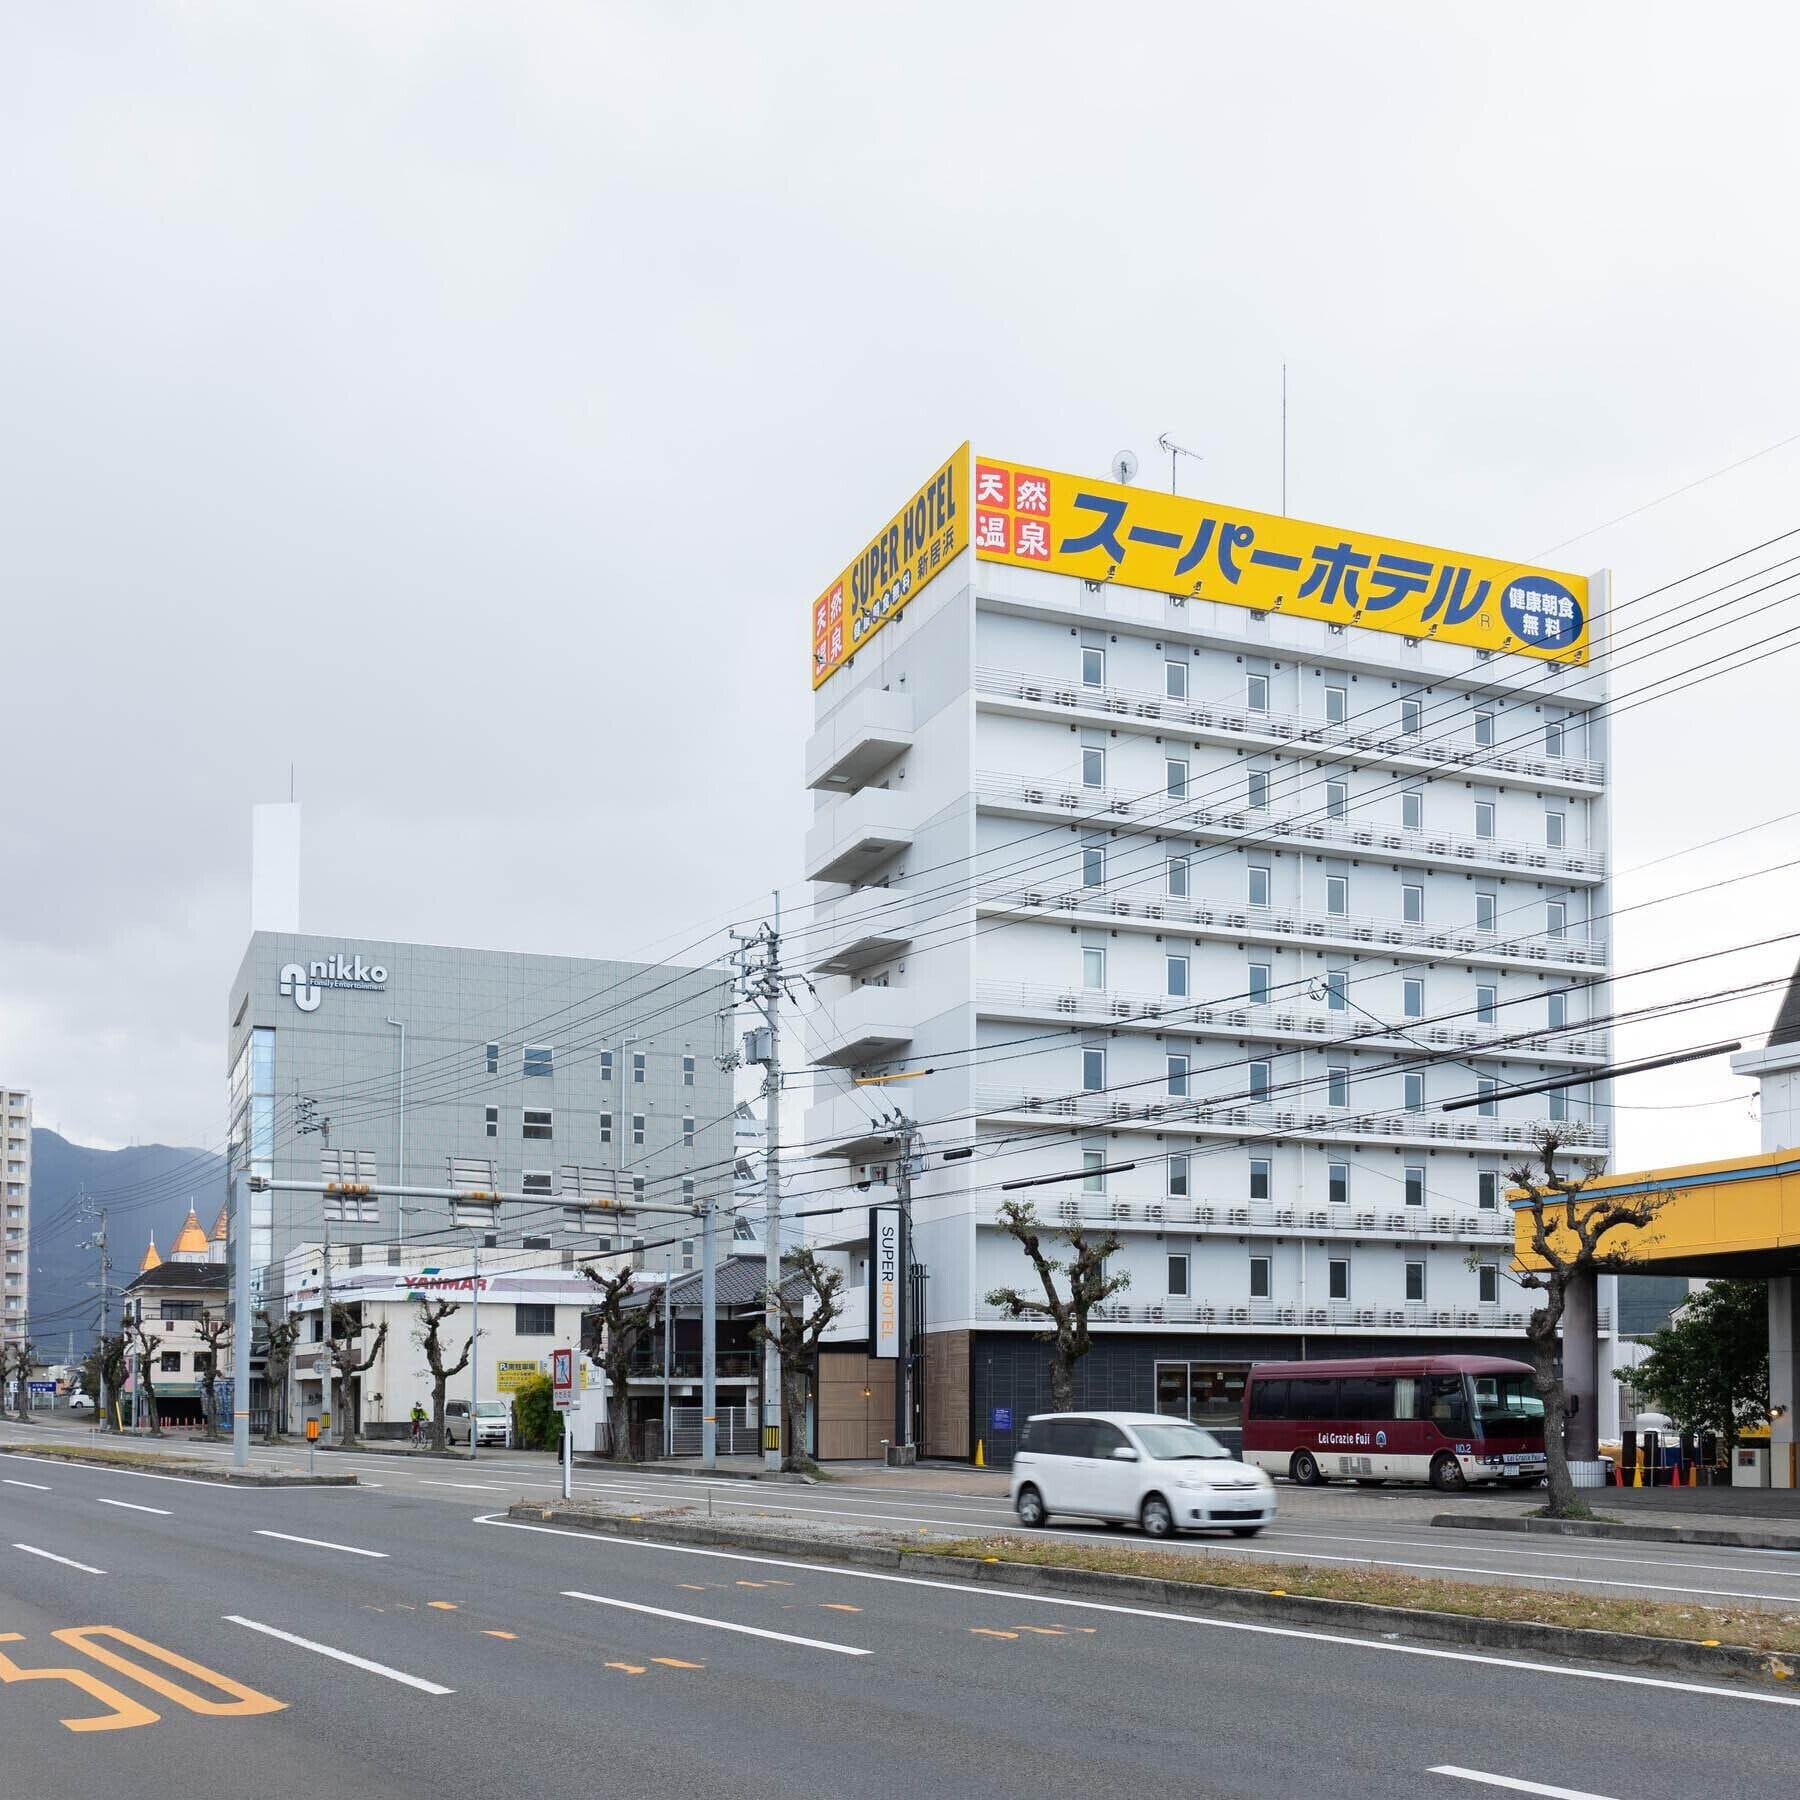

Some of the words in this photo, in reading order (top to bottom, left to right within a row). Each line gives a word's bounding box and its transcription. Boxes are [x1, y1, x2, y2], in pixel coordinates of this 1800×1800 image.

[977, 473, 1048, 511] 天然
[852, 524, 900, 617] SUPER
[903, 463, 956, 564] HOTEL
[917, 524, 955, 581] 新居浜
[976, 516, 1049, 556] 温泉
[1059, 493, 1491, 625] スーパーホテル
[1509, 587, 1574, 619] 健康朝食
[1522, 613, 1560, 640] 無料
[310, 979, 333, 988] Family
[334, 980, 385, 991] Entertainment
[311, 953, 387, 982] nikko
[881, 1226, 895, 1282] SUPER
[403, 1275, 488, 1291] YANMAR
[881, 1283, 895, 1341] HOTEL
[1318, 1432, 1329, 1444] Lei
[1329, 1433, 1354, 1445] Grazie
[1355, 1433, 1370, 1445] Fuji
